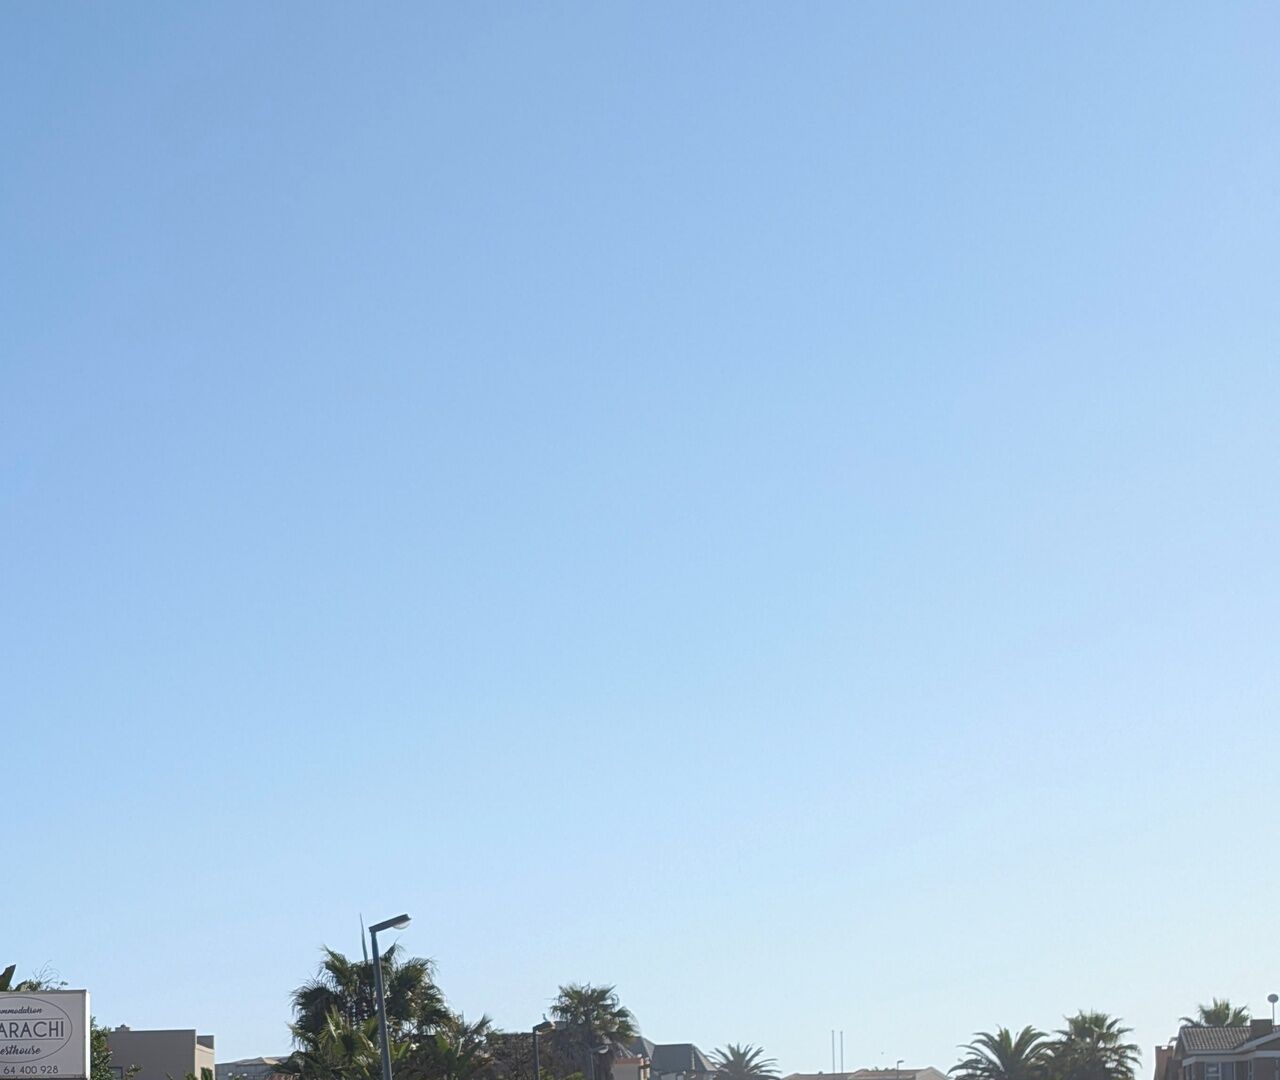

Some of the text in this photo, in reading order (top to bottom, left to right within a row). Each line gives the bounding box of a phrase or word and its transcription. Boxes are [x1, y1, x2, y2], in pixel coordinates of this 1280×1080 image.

[3, 1066, 16, 1075] 64
[20, 1066, 37, 1074] 400
[40, 1065, 59, 1074] 928
